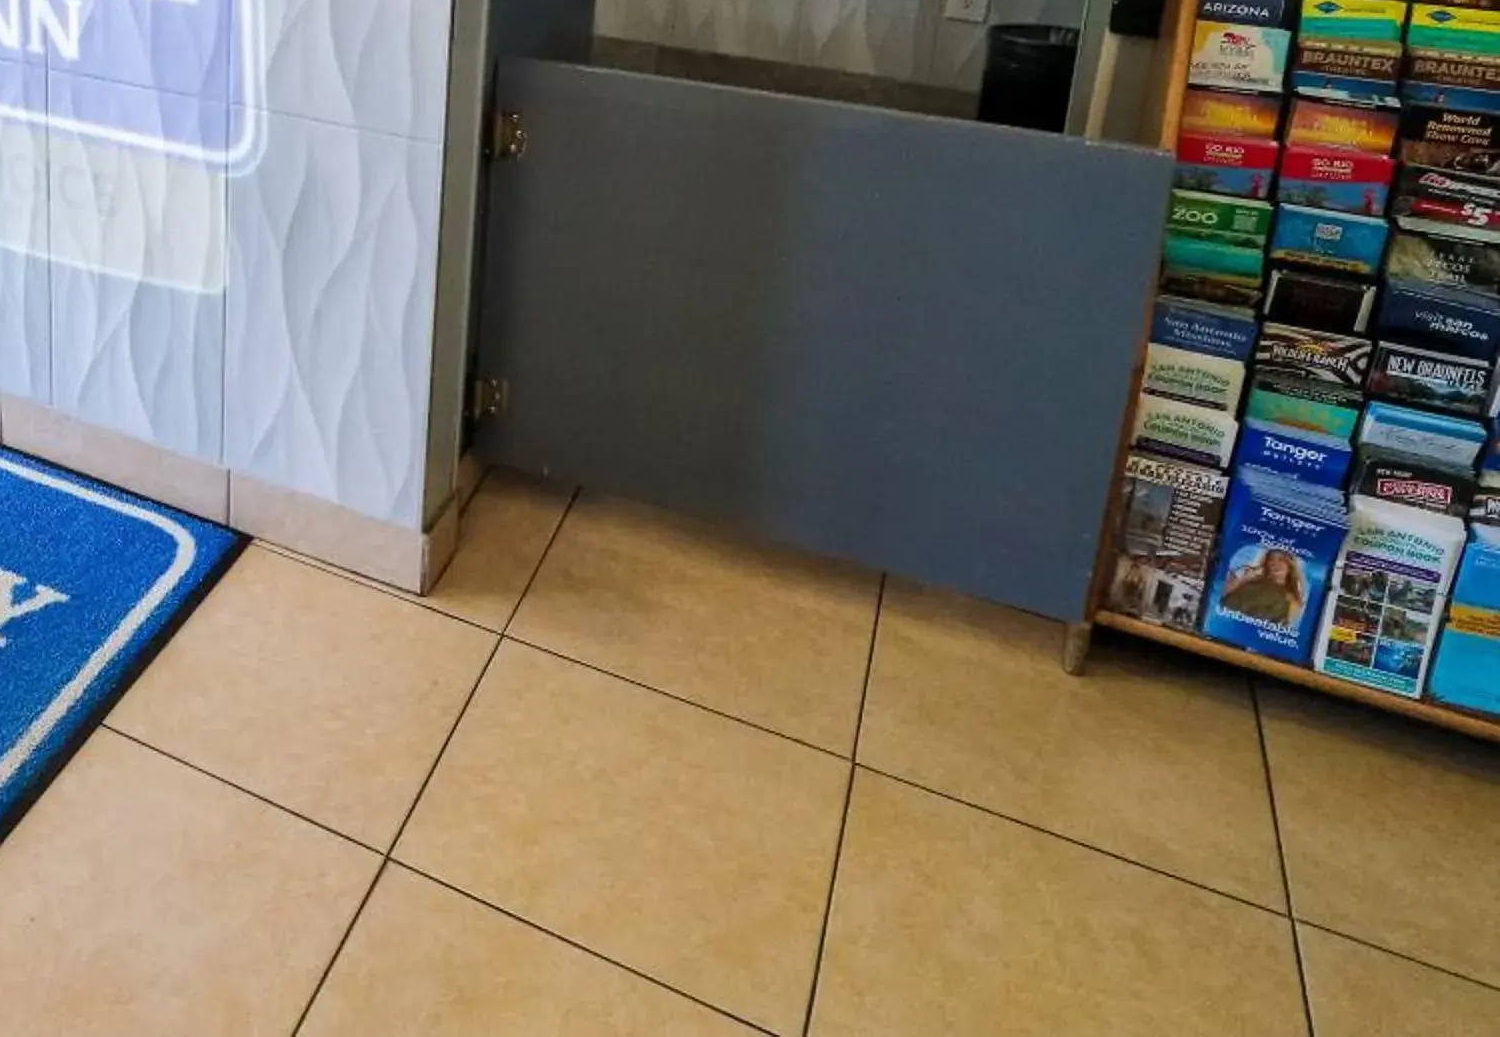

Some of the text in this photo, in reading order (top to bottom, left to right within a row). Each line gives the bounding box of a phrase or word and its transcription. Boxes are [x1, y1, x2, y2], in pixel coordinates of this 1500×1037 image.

[1203, 2, 1270, 18] ARIZONA
[1302, 50, 1394, 73] BRAUNTEX
[1442, 112, 1482, 126] World
[1171, 205, 1220, 225] ZOO
[1387, 354, 1415, 373] NEW
[1264, 436, 1328, 462] Tanger
[1261, 506, 1325, 532] Tanger
[1215, 605, 1300, 638] Unbeatable
